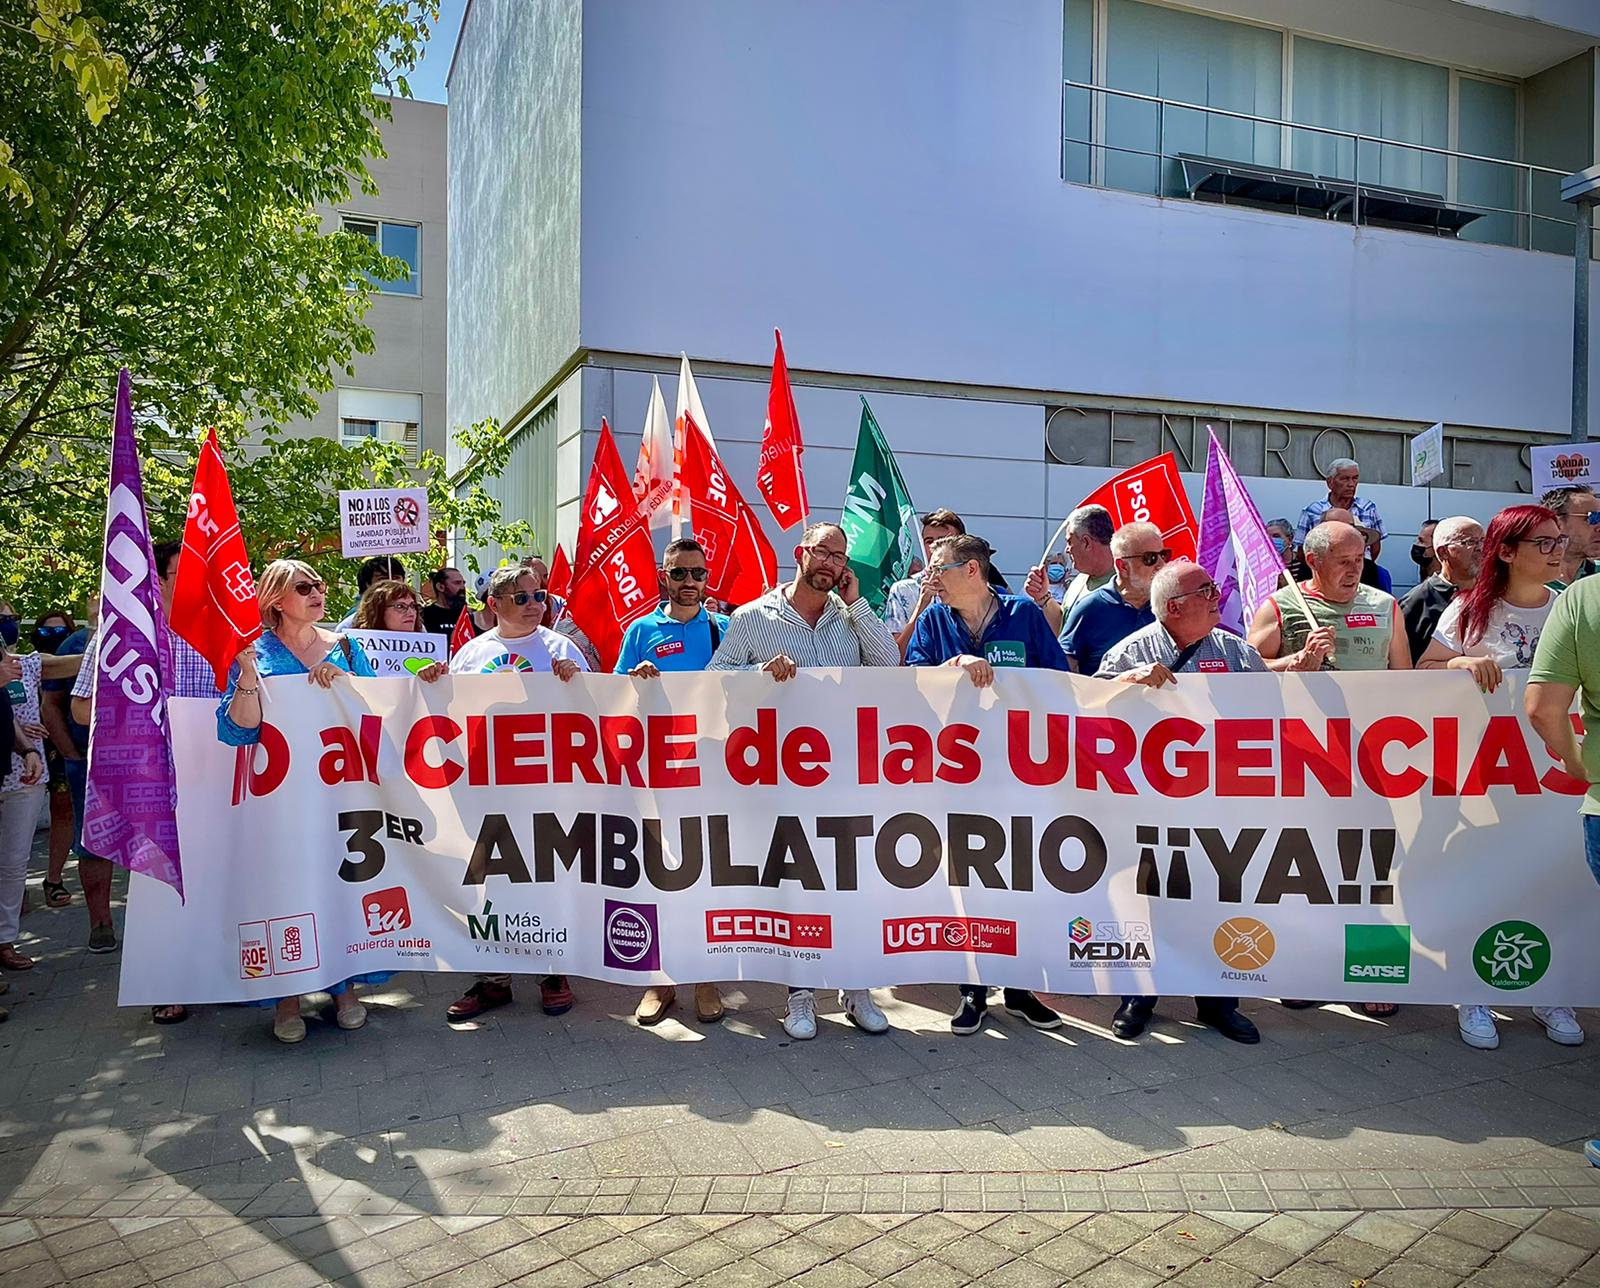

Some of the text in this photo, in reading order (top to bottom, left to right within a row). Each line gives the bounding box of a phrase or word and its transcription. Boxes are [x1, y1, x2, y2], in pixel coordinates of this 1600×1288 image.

[1550, 458, 1590, 469] SANIDAD
[347, 497, 390, 512] NO A LOS
[1127, 479, 1151, 522] PSO
[349, 512, 392, 527] RECORTES
[356, 529, 383, 538] SANIDAD
[350, 540, 384, 549] UNIVERSAL
[391, 537, 422, 546] GRATUITA
[611, 549, 646, 608] PSOE
[656, 641, 682, 653] CCOO
[319, 714, 383, 786] al
[404, 713, 702, 789] CIERRE
[724, 708, 832, 787] de
[856, 707, 982, 785] las
[462, 812, 1108, 894] AMBULATORIO
[1136, 824, 1396, 905] ¡¡YA!!
[505, 911, 541, 928] Más
[612, 927, 645, 938] PODEMOS
[712, 915, 790, 940] CCOO
[886, 922, 942, 948] UGT
[981, 924, 1010, 935] Madrid
[1096, 921, 1151, 941] SUR
[398, 937, 431, 949] unida
[506, 927, 568, 944] Madrid
[475, 945, 564, 957] VALDEMORO
[981, 940, 992, 948] Sur
[1069, 942, 1151, 960] MEDIA
[735, 945, 776, 955] comarcal
[777, 947, 791, 958] Las
[793, 950, 821, 961] Vegas
[1220, 971, 1268, 983] ACUSVAL
[1349, 965, 1405, 978] SATSE
